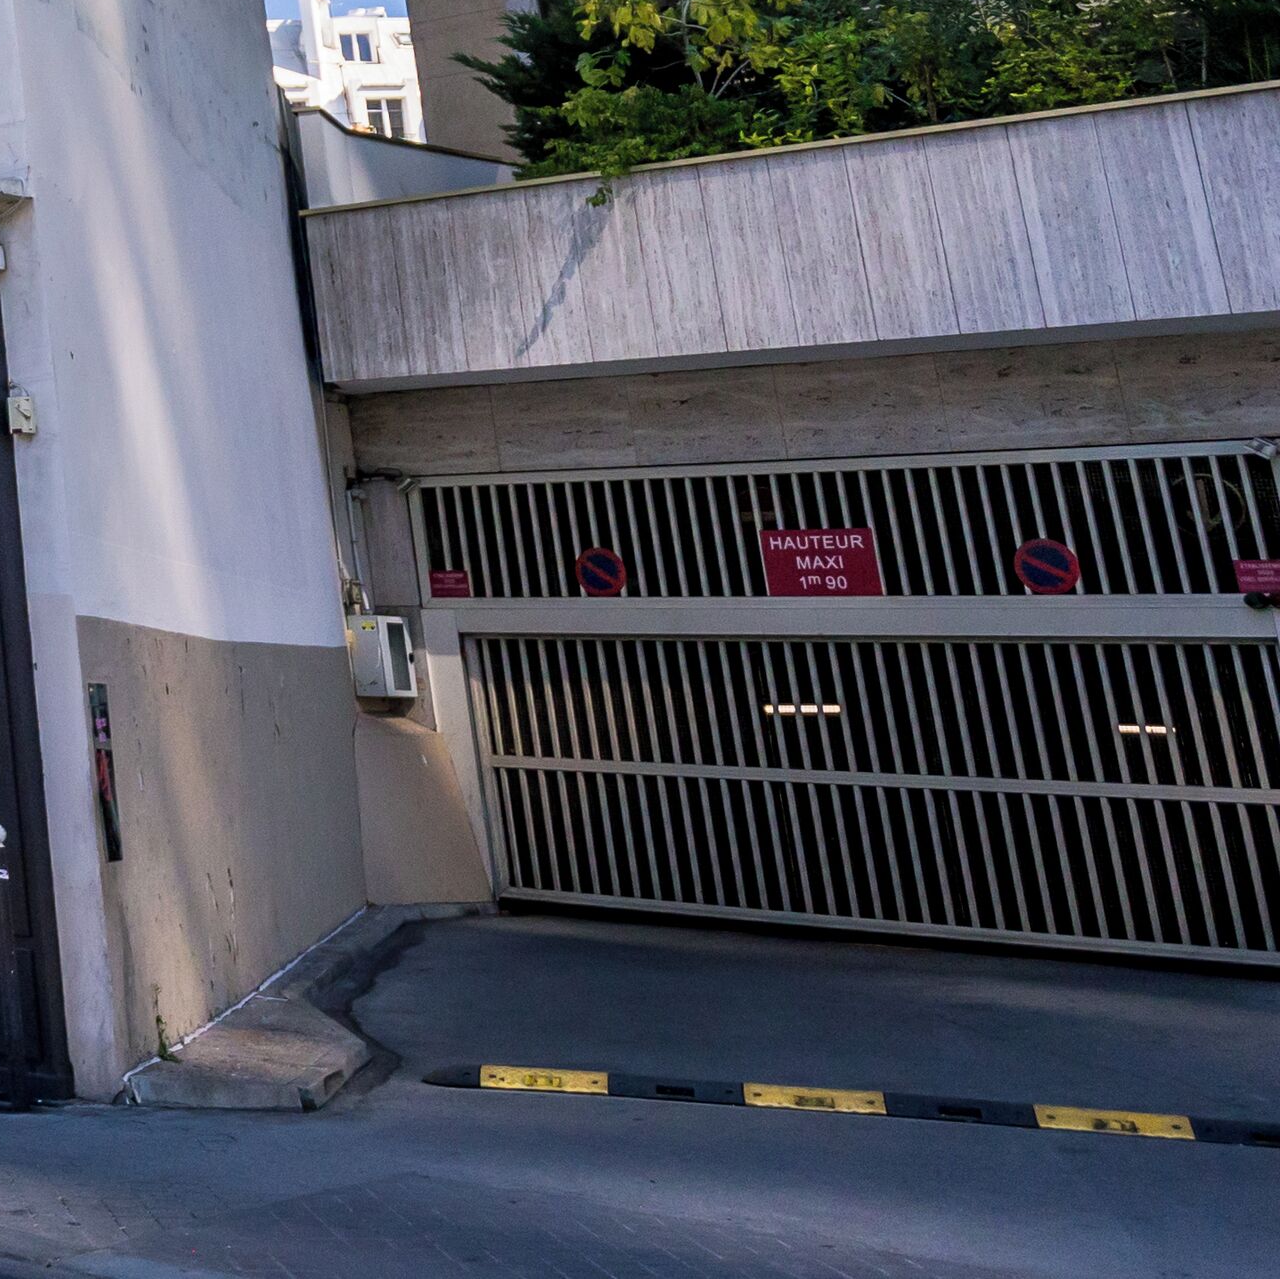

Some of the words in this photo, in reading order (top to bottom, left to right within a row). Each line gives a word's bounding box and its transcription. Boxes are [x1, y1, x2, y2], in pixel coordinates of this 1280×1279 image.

[769, 535, 865, 550] HAUTEUR
[796, 555, 844, 570] MAXI
[825, 575, 848, 590] 90
